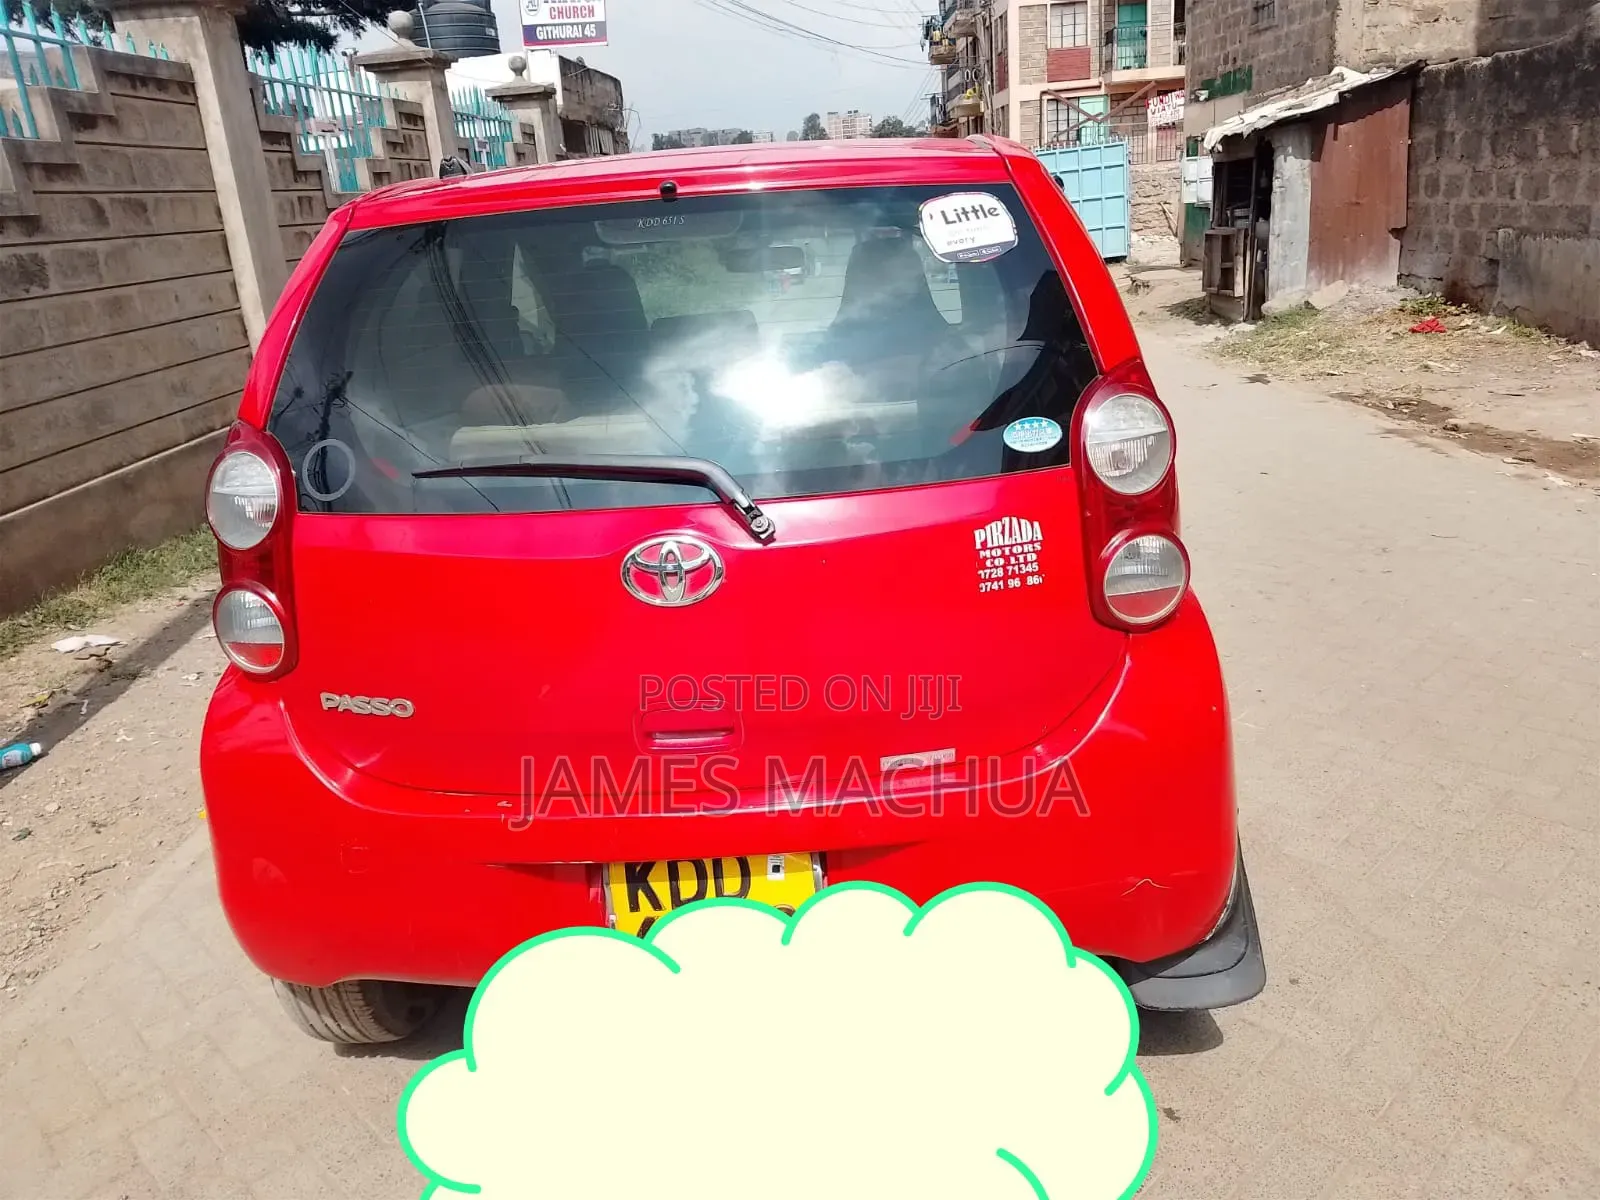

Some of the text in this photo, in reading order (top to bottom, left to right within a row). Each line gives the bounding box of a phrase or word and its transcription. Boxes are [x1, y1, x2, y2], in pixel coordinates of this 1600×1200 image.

[550, 6, 595, 19] CHURCH
[536, 23, 597, 39] GITHURAI 45
[940, 203, 1000, 225] Little
[638, 217, 661, 229] KDD
[974, 516, 1044, 550] PIRZADA
[979, 542, 1042, 559] MOTORS
[1008, 577, 1021, 589] 96
[320, 691, 415, 718] PASSO
[624, 856, 751, 913] KDD
